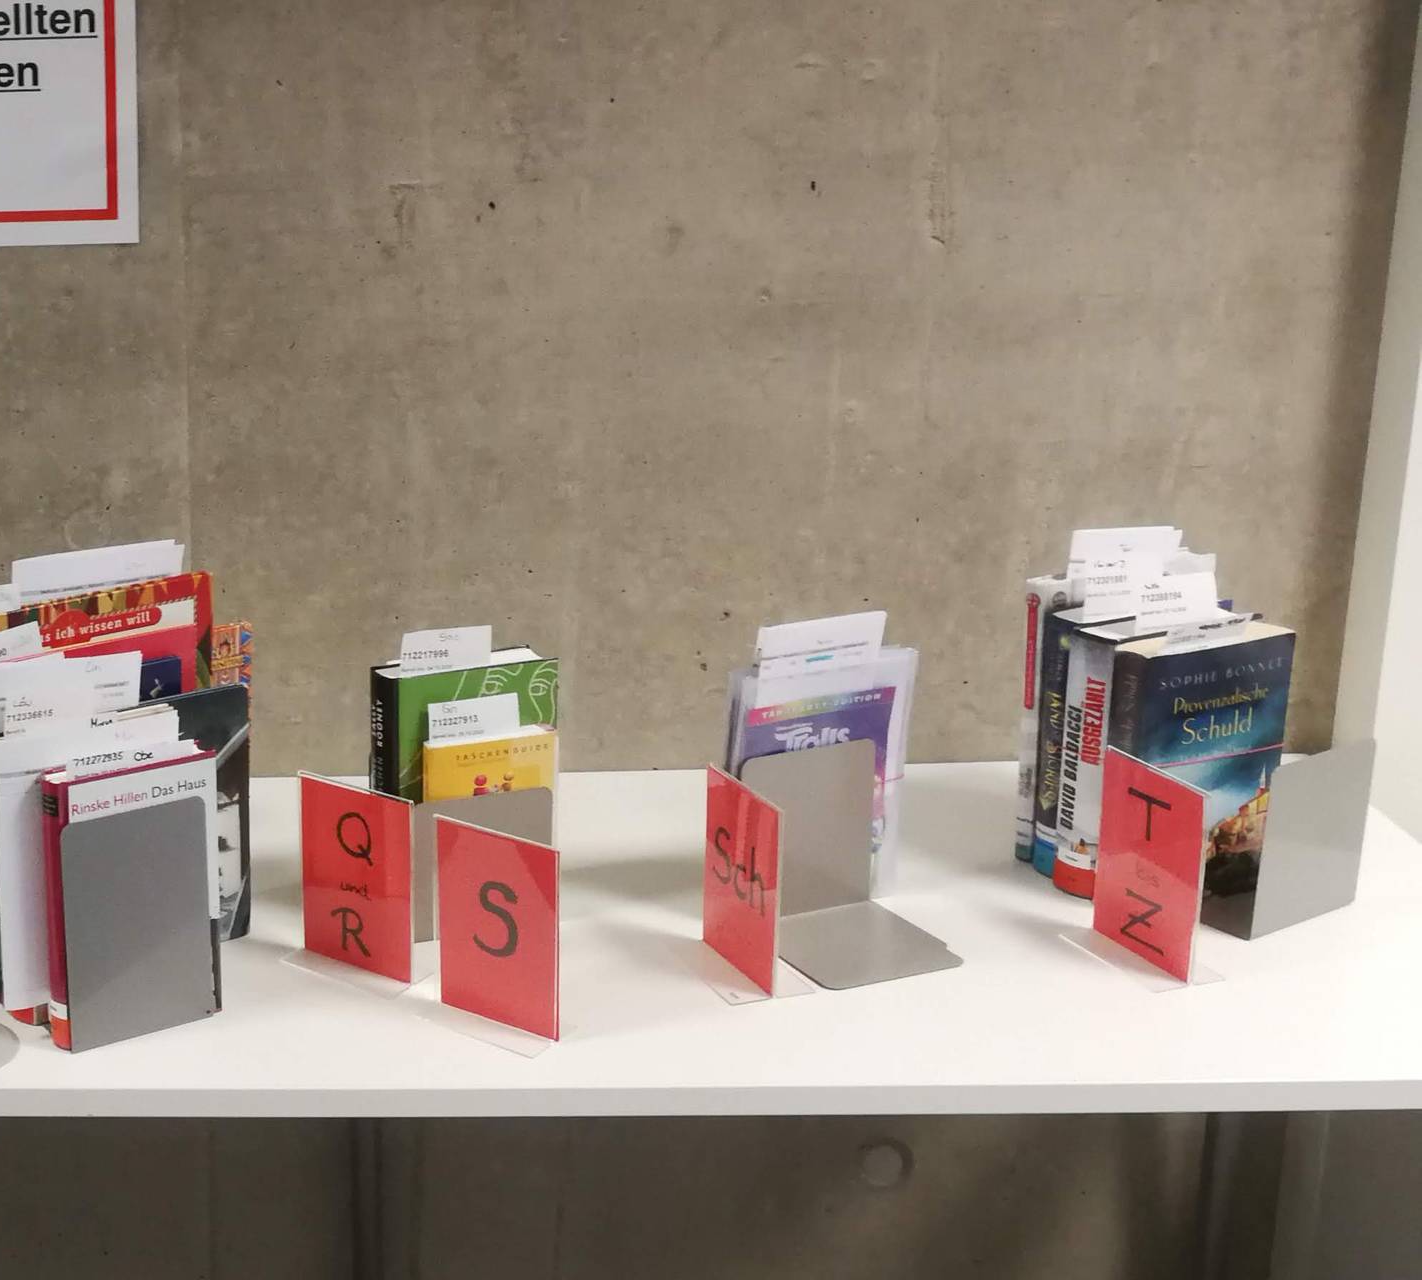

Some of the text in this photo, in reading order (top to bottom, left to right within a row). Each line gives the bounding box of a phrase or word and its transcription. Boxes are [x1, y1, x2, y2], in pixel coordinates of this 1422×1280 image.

[55, 626, 76, 640] ich
[79, 618, 122, 636] wissen
[126, 611, 151, 625] will
[1159, 670, 1217, 690] SOPHIE
[1180, 706, 1253, 745] Schuld
[1059, 705, 1082, 830] DAVID BALDACCI
[71, 799, 110, 816] Rinske
[113, 790, 148, 807] Hillen
[151, 785, 175, 799] Das
[178, 777, 207, 792] Haus
[1127, 786, 1172, 842] T
[335, 811, 374, 867] Q
[339, 881, 373, 901] und
[711, 825, 766, 917] Sch
[330, 906, 372, 957] R
[472, 880, 519, 957] S
[1119, 886, 1165, 957] Z
